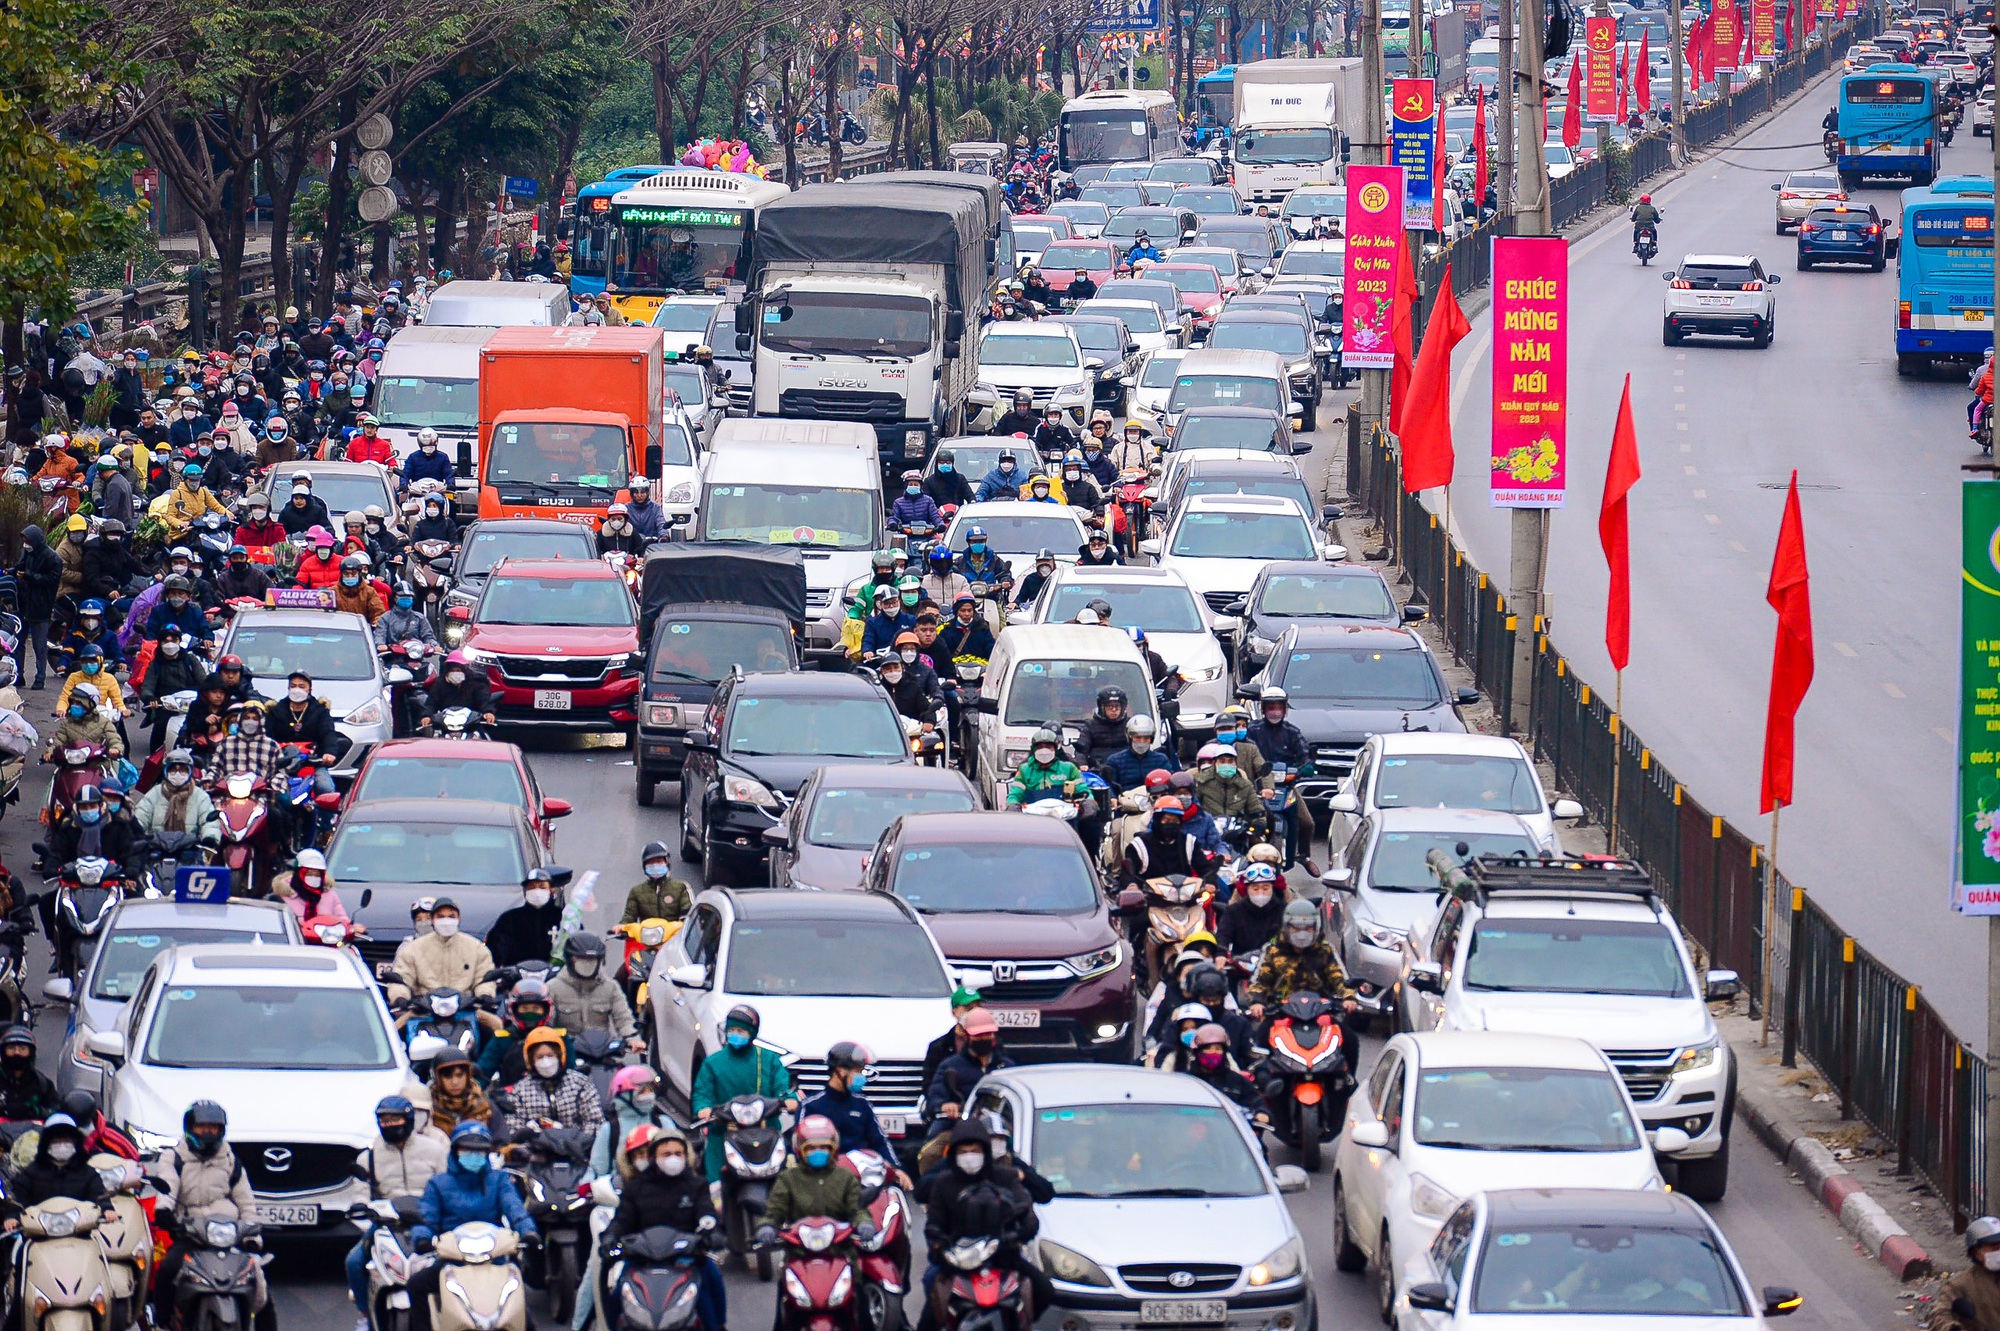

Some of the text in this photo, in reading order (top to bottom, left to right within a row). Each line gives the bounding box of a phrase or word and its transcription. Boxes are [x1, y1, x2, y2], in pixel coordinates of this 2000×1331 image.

[1350, 233, 1395, 248] Chào Xuân
[1354, 257, 1391, 272] Quý Mão
[1357, 279, 1387, 293] 2023
[1505, 276, 1557, 299] CHÚC
[1949, 295, 1964, 304] 29B
[1504, 307, 1558, 330] MỪNG
[1510, 338, 1550, 362] NĂM
[818, 377, 869, 388] ISUZU
[1512, 370, 1548, 393] MỚI
[1501, 400, 1522, 411] XUÂN
[1524, 400, 1540, 412] QUÝ
[1520, 415, 1540, 424] 2023
[538, 498, 574, 506] ISUZU
[1495, 492, 1562, 503] QUẬN HOÀNG MAI
[820, 532, 833, 540] 45
[545, 692, 561, 700] 30G
[1976, 687, 1998, 701] THỰC
[538, 701, 567, 709] 628.02
[1970, 748, 1994, 764] QUỐC
[188, 871, 217, 900] G7
